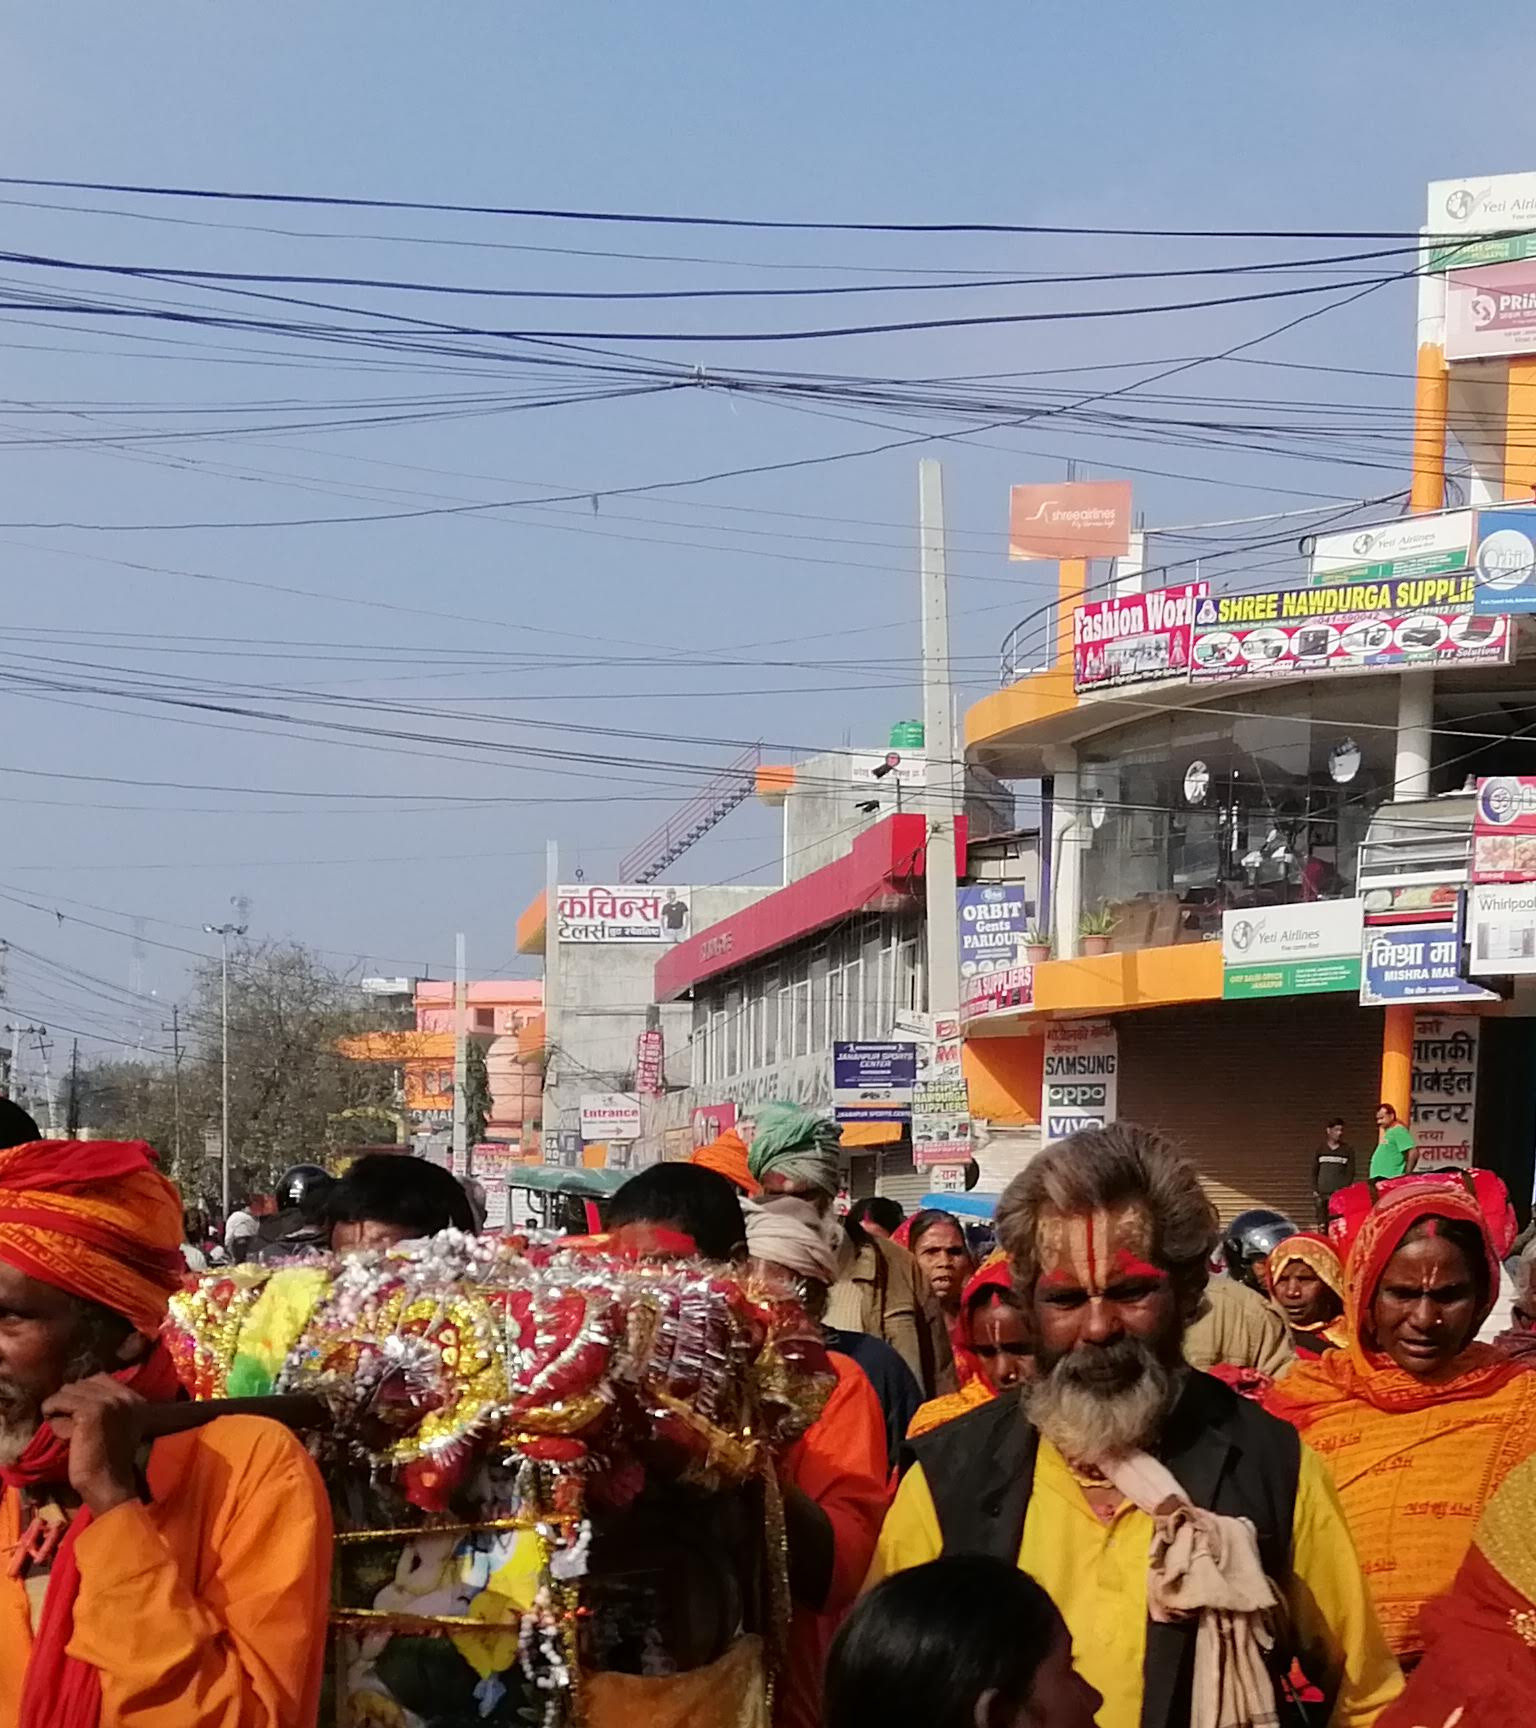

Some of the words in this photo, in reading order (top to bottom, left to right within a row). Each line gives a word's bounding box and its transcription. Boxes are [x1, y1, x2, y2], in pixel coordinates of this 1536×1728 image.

[1219, 592, 1277, 623] SHREE
[1282, 583, 1391, 618] NAWDURGA
[1074, 600, 1145, 646] Fashion
[963, 901, 1022, 921] ORBIT
[975, 920, 1011, 933] Gents
[1258, 932, 1278, 945] Yeti
[1281, 929, 1320, 943] Airlines
[983, 966, 1032, 996] SUPPLIERS
[1384, 969, 1429, 982] MISHRA
[882, 1052, 914, 1061] SPORTS
[859, 1060, 892, 1068] CENTER
[1045, 1054, 1116, 1076] SAMSUNG
[582, 1108, 639, 1118] Entrance
[914, 1102, 969, 1113] SUPPLIERS
